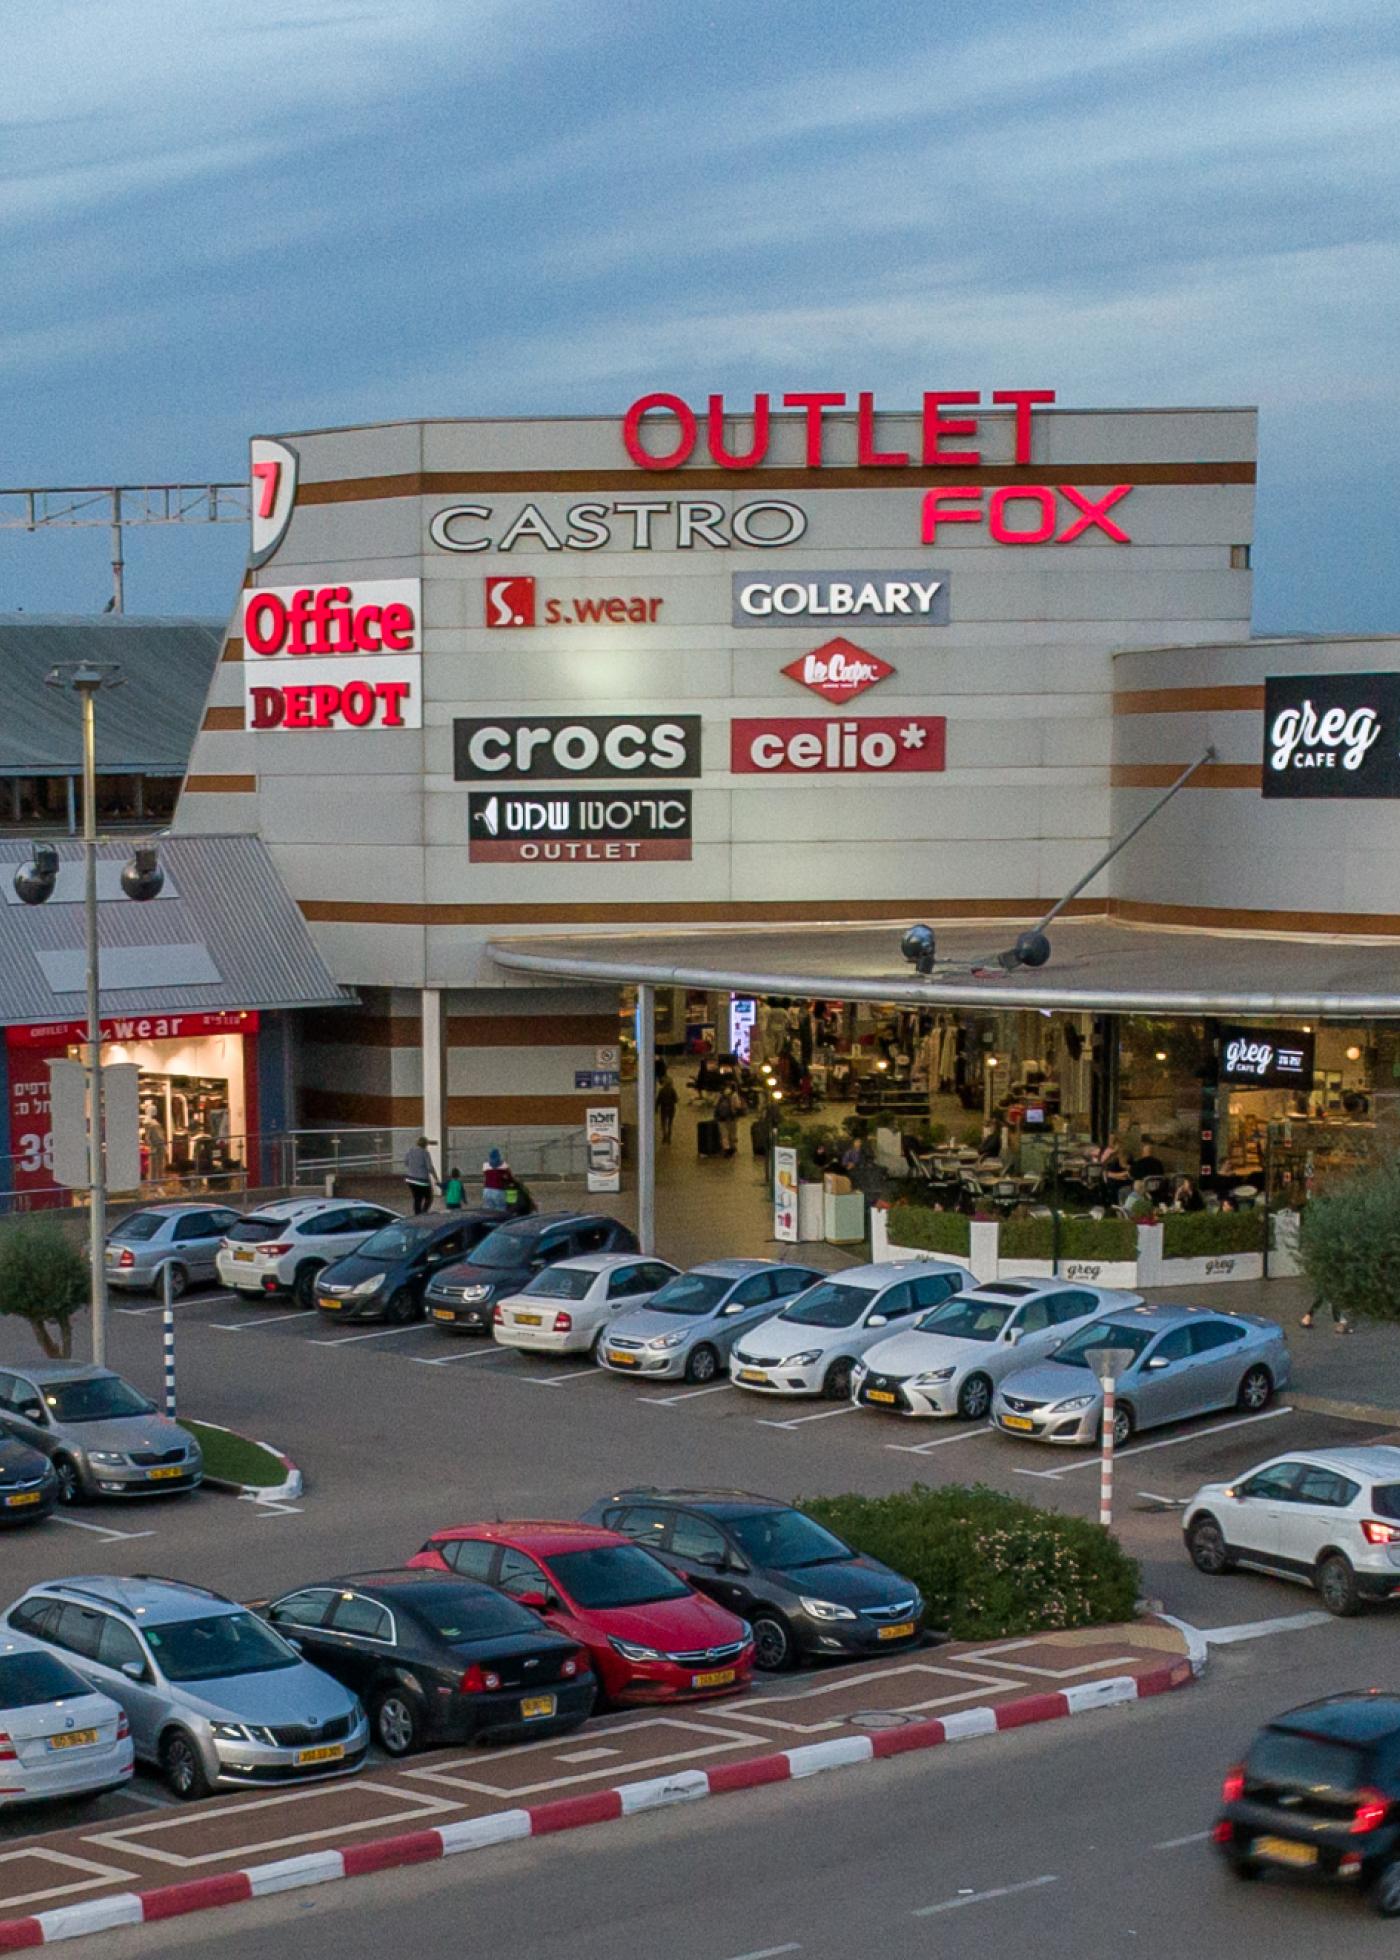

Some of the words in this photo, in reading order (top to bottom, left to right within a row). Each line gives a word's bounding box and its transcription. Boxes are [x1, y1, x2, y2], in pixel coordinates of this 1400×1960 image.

[622, 390, 1056, 471] OUTLET
[253, 462, 280, 518] 7
[429, 499, 808, 552] CASTRO
[921, 484, 1133, 545] FOX
[245, 586, 415, 656] Office
[545, 596, 664, 625] s.wear
[739, 581, 942, 616] GOLBARY
[249, 681, 410, 729] DEPOT
[469, 724, 687, 772] crocs
[1271, 699, 1382, 771] greg
[1293, 752, 1337, 769] CAFE
[519, 842, 642, 859] OUTLET
[1226, 1037, 1274, 1075] greg
